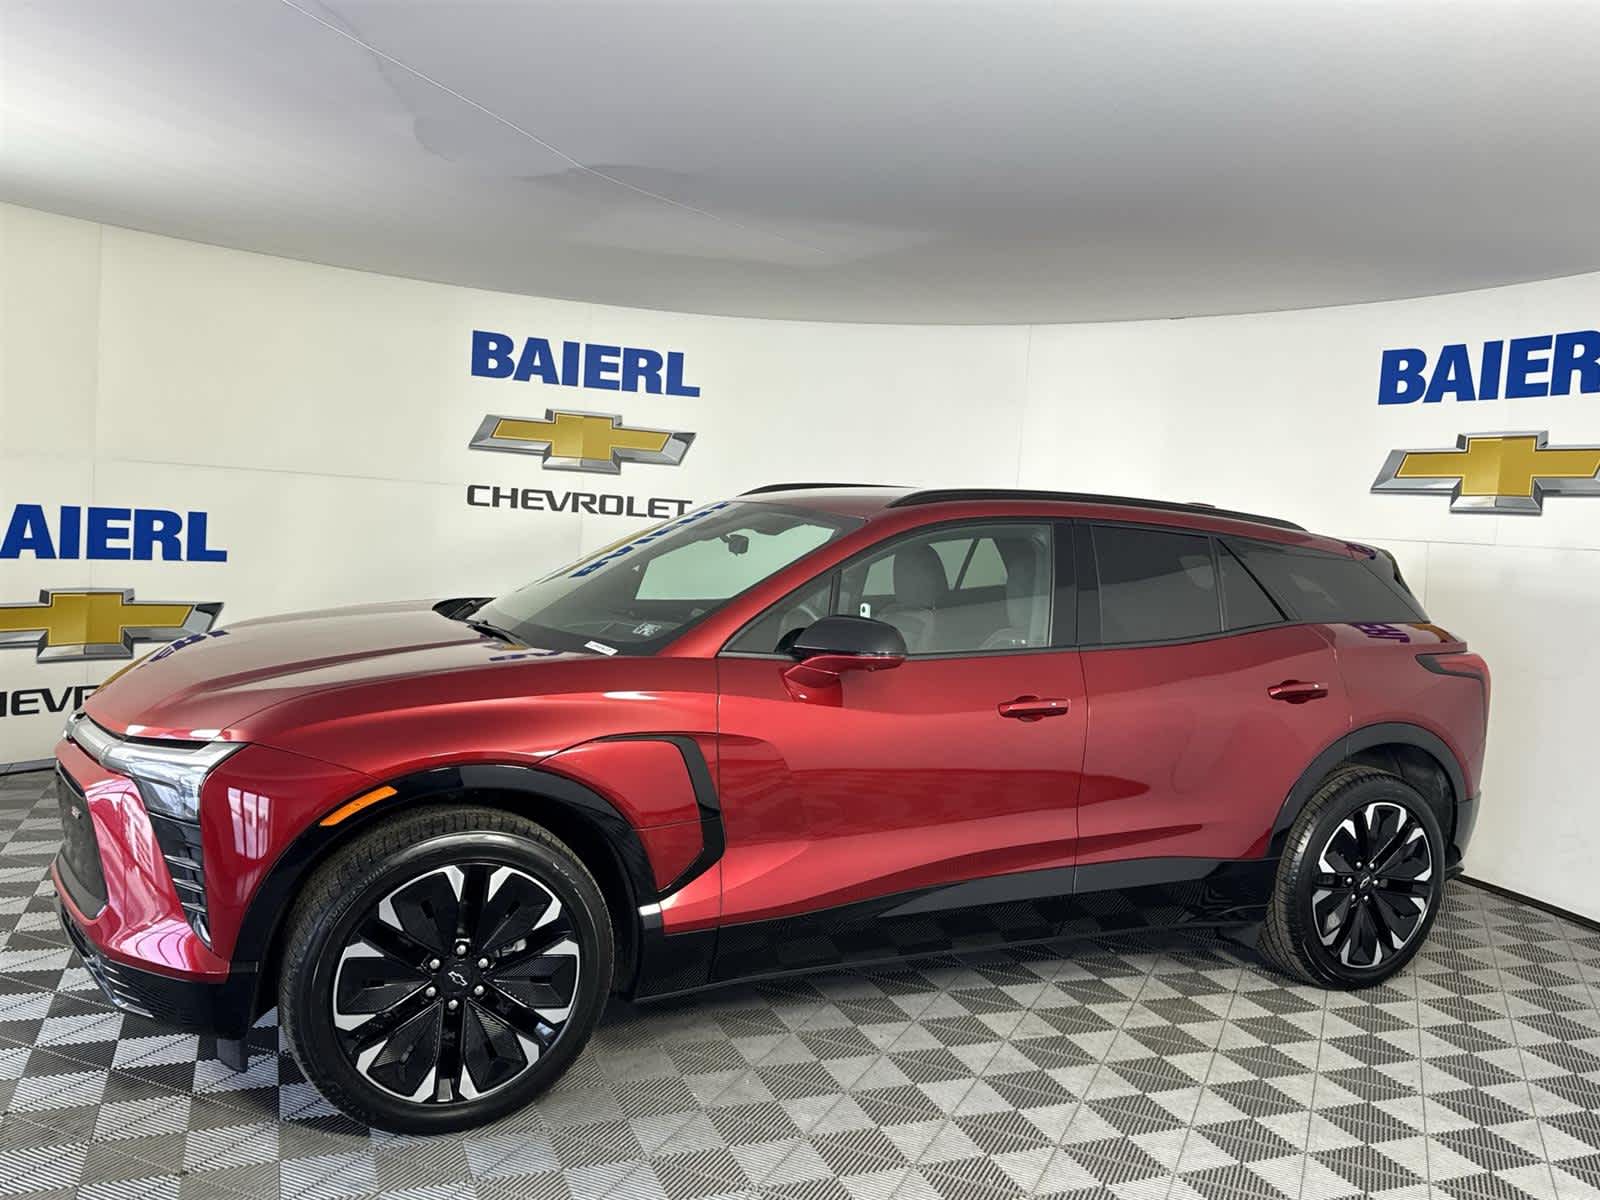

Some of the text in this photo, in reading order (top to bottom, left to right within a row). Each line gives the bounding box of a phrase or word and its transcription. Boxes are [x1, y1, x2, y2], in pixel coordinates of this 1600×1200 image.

[471, 330, 701, 398] BAIERL
[1377, 330, 1600, 406] BAIER
[0, 503, 228, 563] AIERL
[466, 484, 693, 519] CHEVROLET
